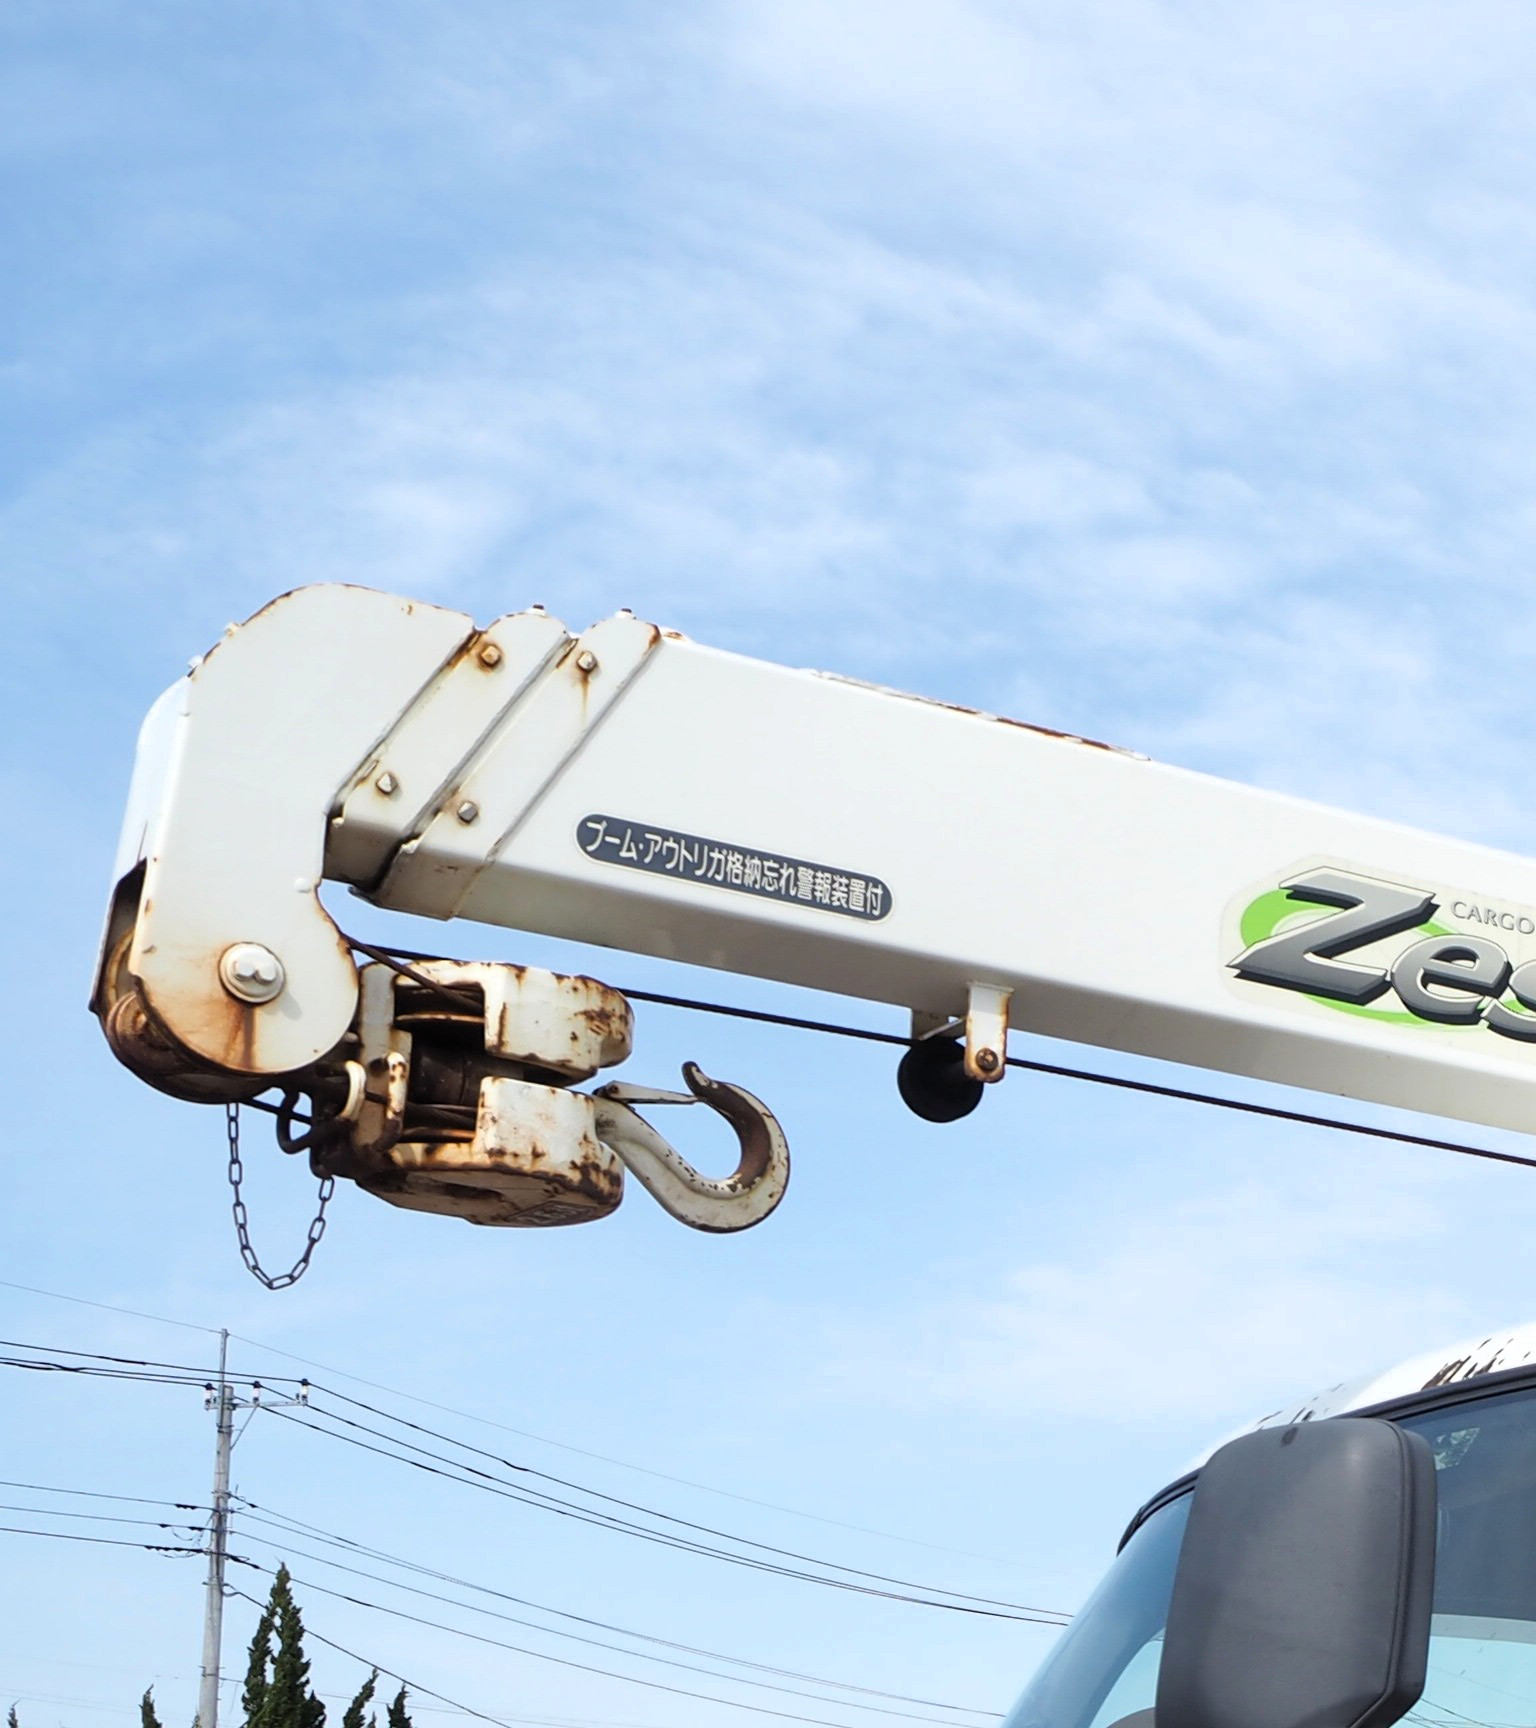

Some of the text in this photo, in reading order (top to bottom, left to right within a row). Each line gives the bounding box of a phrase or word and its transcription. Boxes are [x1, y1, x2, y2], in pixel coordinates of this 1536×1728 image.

[585, 820, 884, 916] ブーム・アウトリガ格納忘れ警報装置付
[1451, 899, 1535, 936] CARGO
